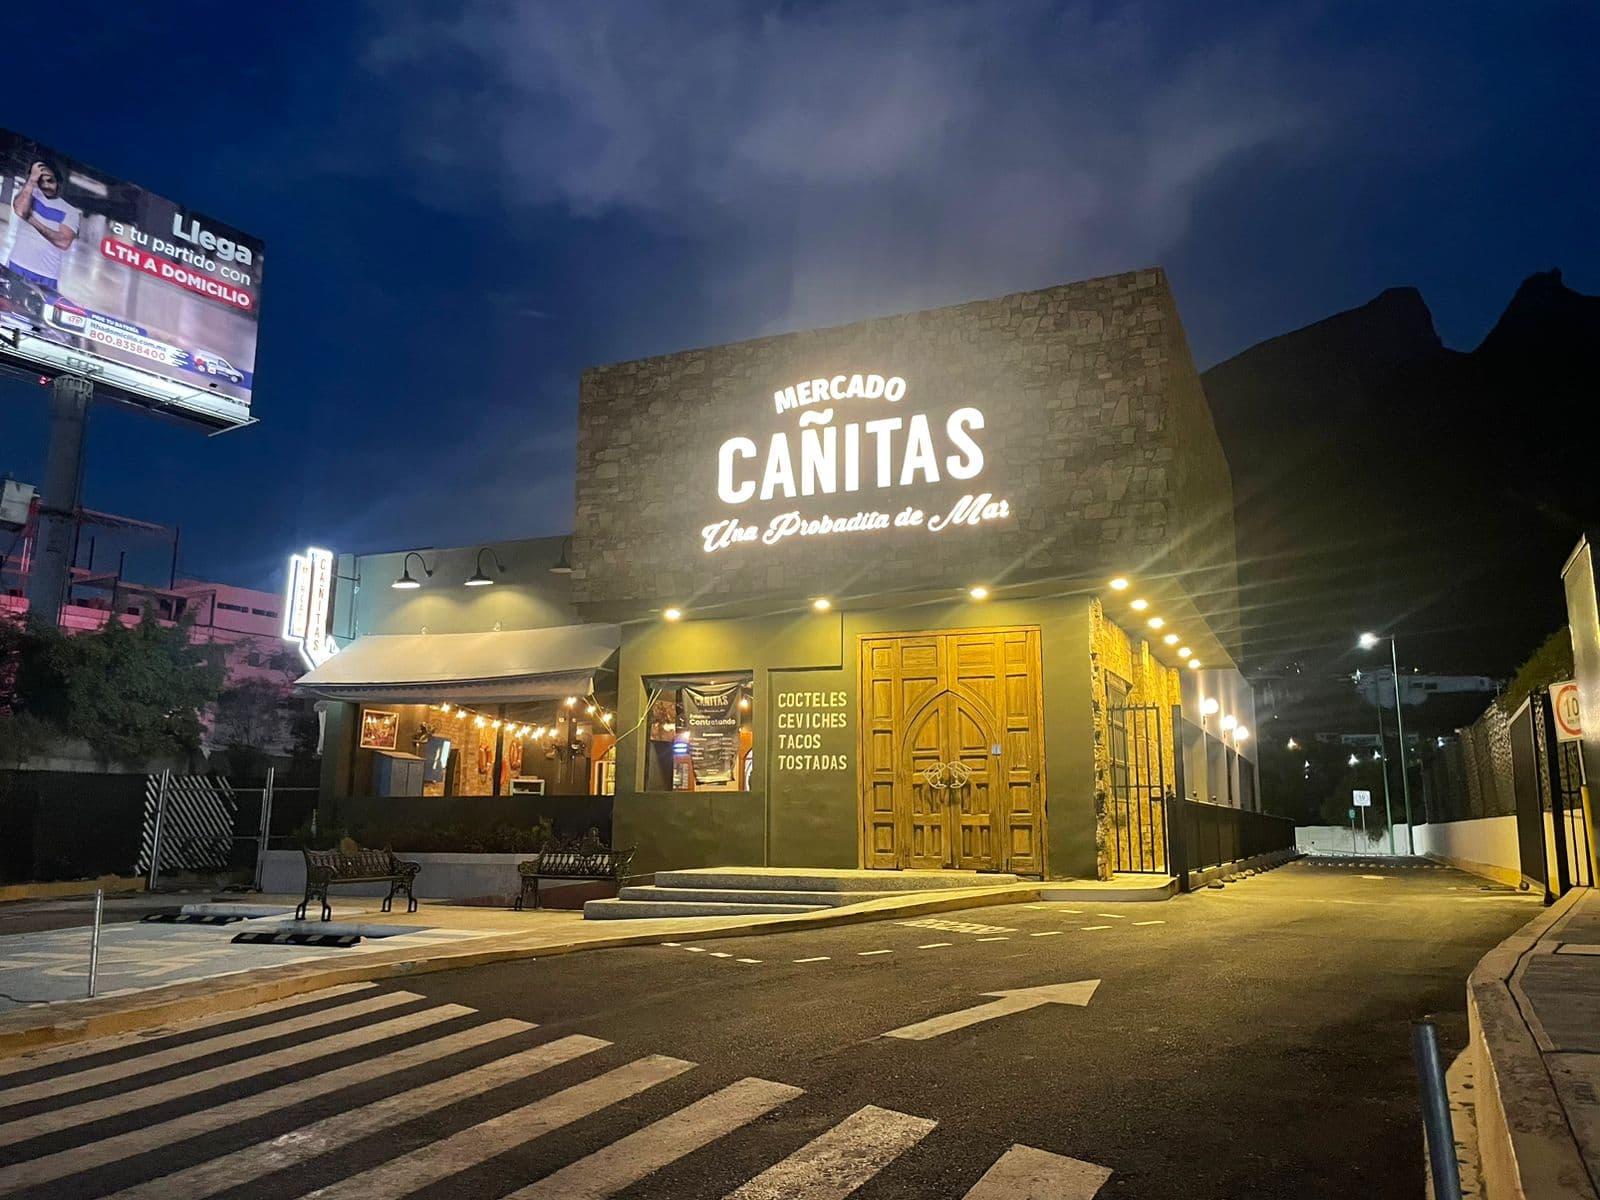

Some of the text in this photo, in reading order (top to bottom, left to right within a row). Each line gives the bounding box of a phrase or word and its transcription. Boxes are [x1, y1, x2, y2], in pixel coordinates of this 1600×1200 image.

[112, 222, 250, 286] a tu partido con
[173, 213, 252, 265] Llega
[105, 241, 250, 306] LTH A DOMICILIO
[89, 329, 166, 361] 800.8358400
[774, 374, 907, 414] MERCADO
[717, 407, 985, 504] CAÑITAS
[701, 493, 1010, 552] Una Probadita de Mar
[778, 691, 848, 708] COCTELES
[1564, 697, 1580, 717] 10
[689, 718, 736, 726] Contratando
[778, 712, 848, 729] CEVICHES
[778, 733, 821, 750] TACOS
[778, 754, 848, 770] TOSTADAS
